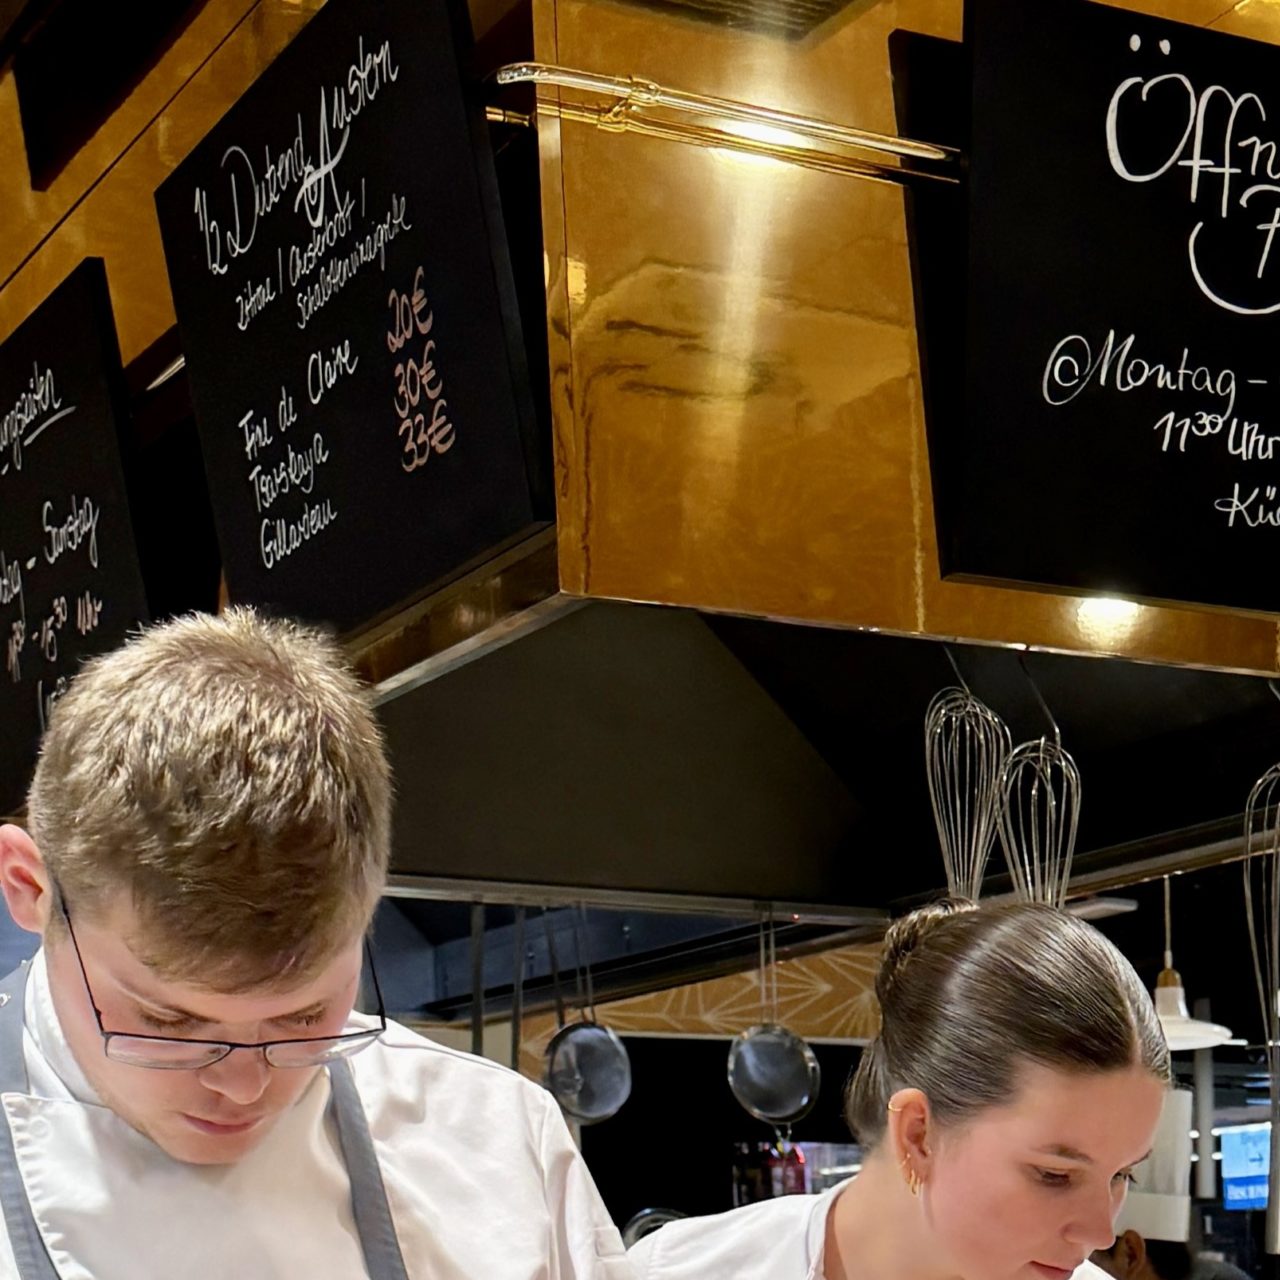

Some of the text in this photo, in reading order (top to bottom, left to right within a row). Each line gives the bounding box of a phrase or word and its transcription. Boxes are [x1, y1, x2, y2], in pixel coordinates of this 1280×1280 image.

[294, 35, 399, 227] Austern
[387, 265, 433, 353] 20€
[307, 339, 358, 404] Claire
[394, 340, 442, 418] 30€
[399, 399, 456, 472] 33€
